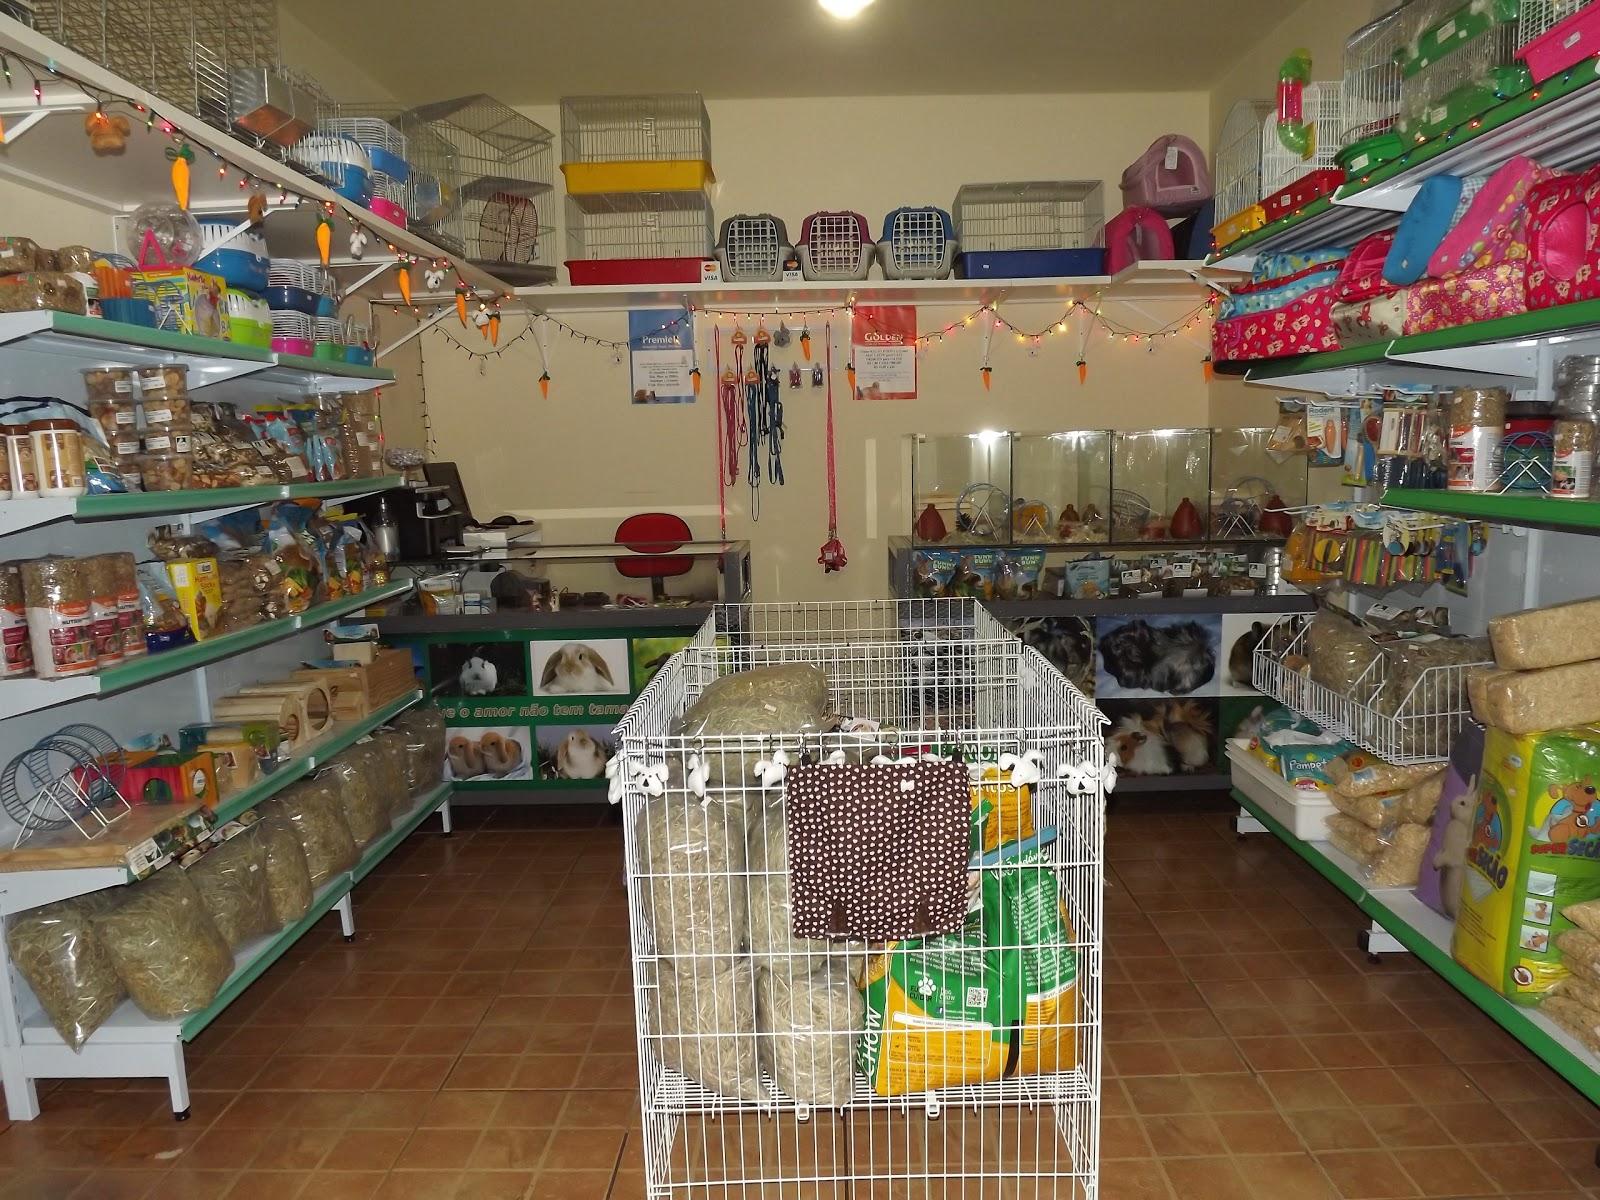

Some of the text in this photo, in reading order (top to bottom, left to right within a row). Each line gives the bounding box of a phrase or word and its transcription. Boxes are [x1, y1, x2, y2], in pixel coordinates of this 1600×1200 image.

[864, 332, 903, 341] GOLDEN
[459, 707, 470, 718] o
[474, 706, 515, 718] amor
[519, 704, 549, 717] não
[553, 703, 584, 716] tem
[588, 702, 629, 715] tama
[862, 1006, 882, 1077] CHOW
